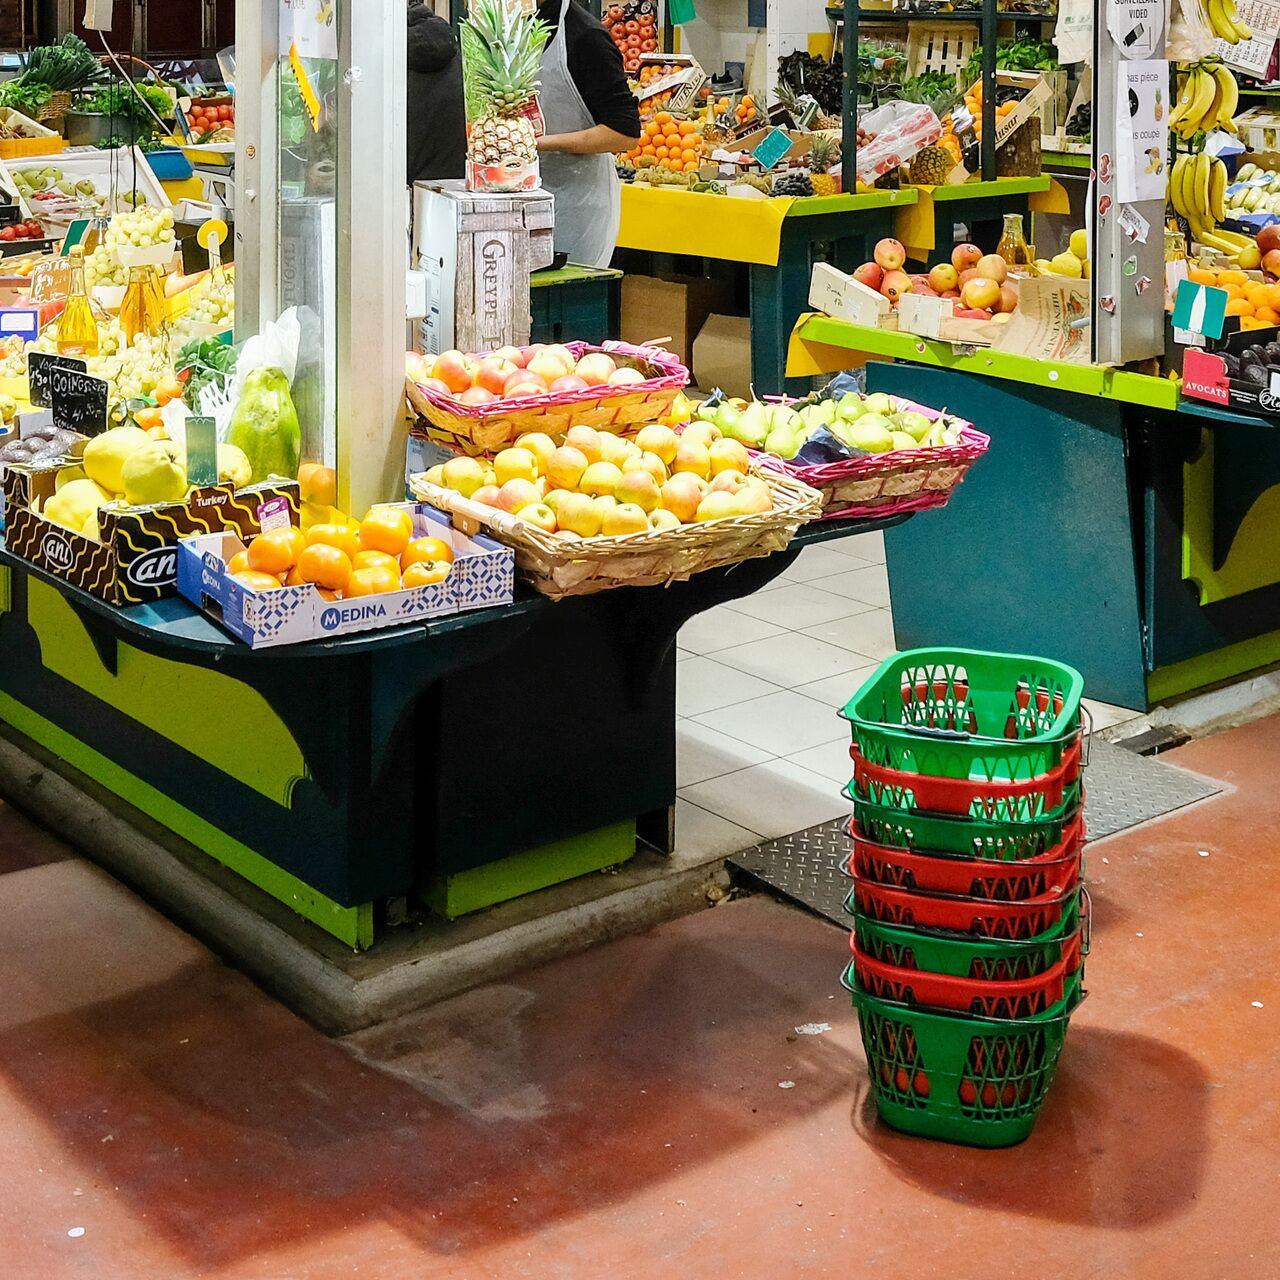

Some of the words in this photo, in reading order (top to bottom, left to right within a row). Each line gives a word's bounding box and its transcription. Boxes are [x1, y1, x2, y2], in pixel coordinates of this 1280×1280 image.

[1128, 9, 1148, 19] VIDEO
[1140, 72, 1159, 84] pièce
[995, 114, 1019, 141] usar
[1185, 381, 1227, 399] AVOCATS
[196, 494, 229, 507] Turkey
[46, 539, 69, 564] ani
[136, 552, 178, 580] an
[320, 605, 387, 631] MEDINA
